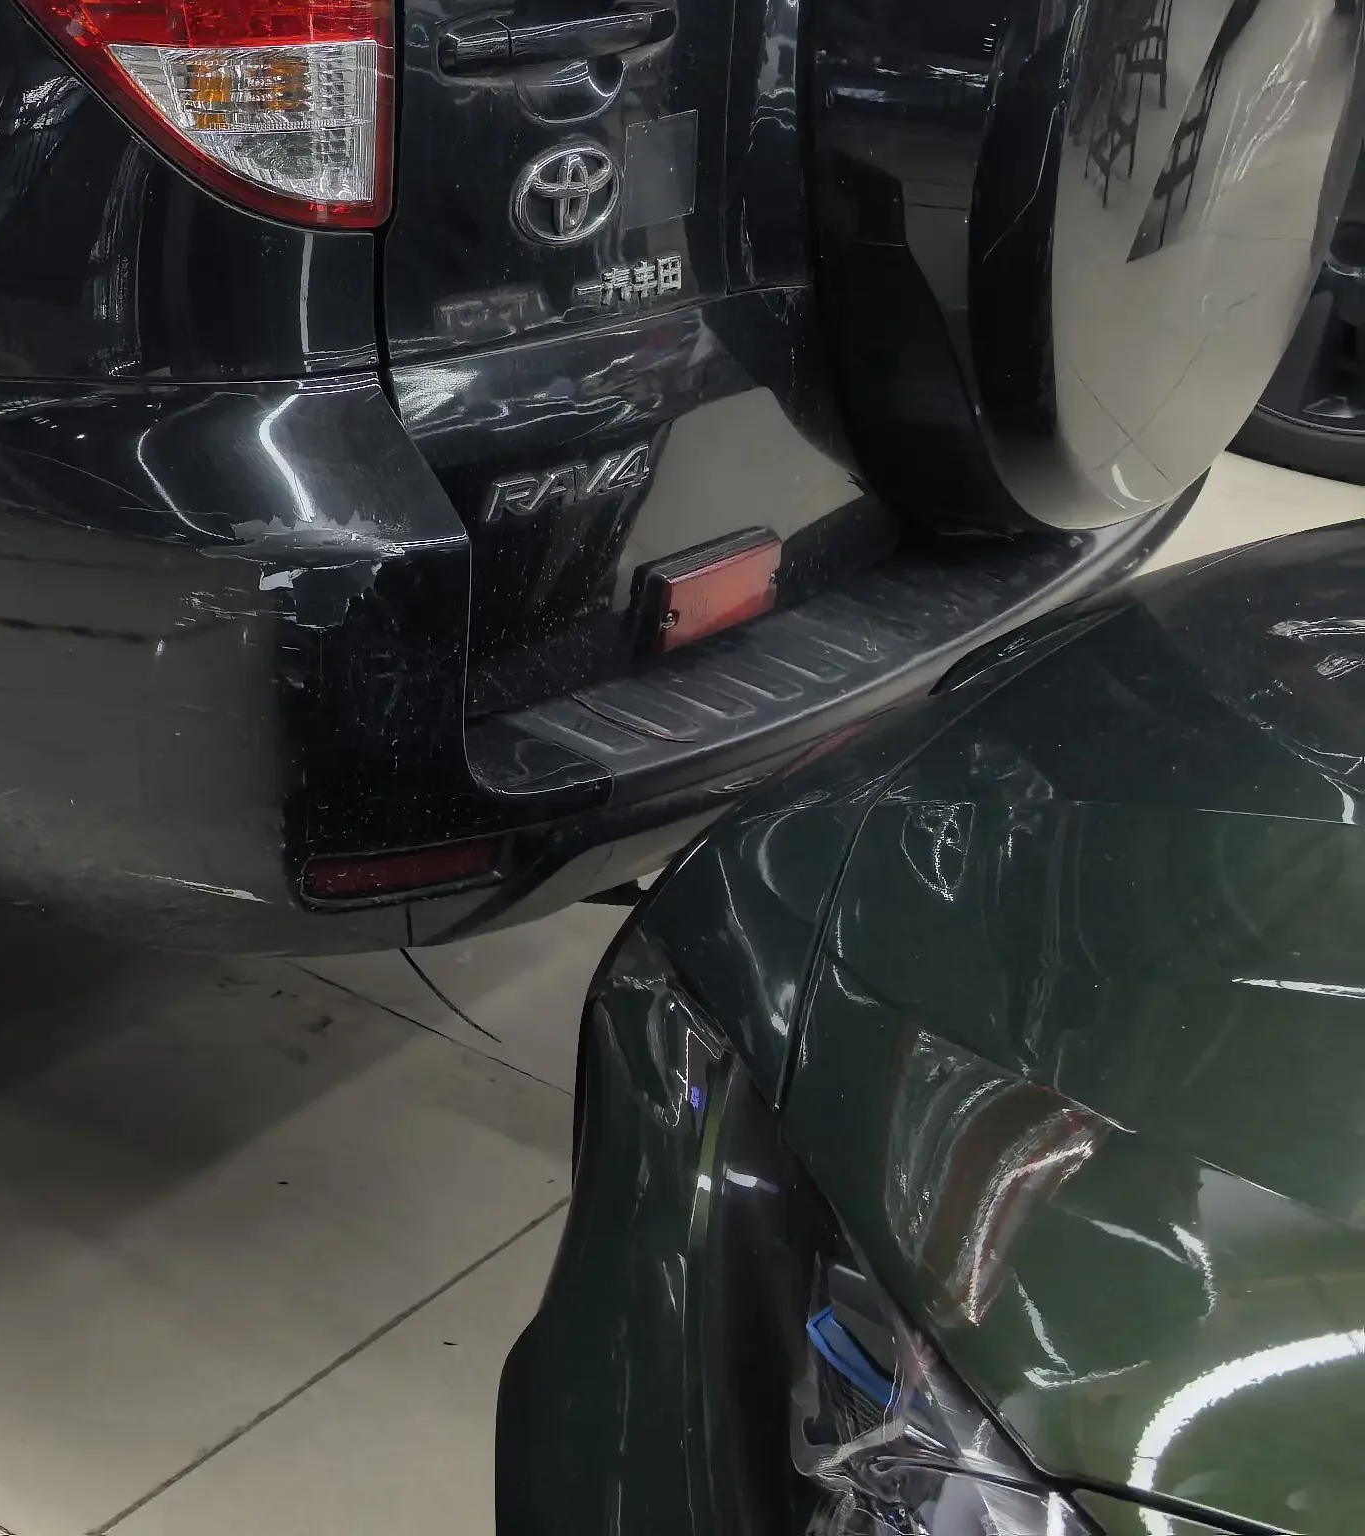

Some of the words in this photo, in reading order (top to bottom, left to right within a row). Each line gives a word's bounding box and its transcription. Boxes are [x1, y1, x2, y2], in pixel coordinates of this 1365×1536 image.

[574, 252, 683, 306] 一汽丰田
[485, 444, 652, 524] RAV4
